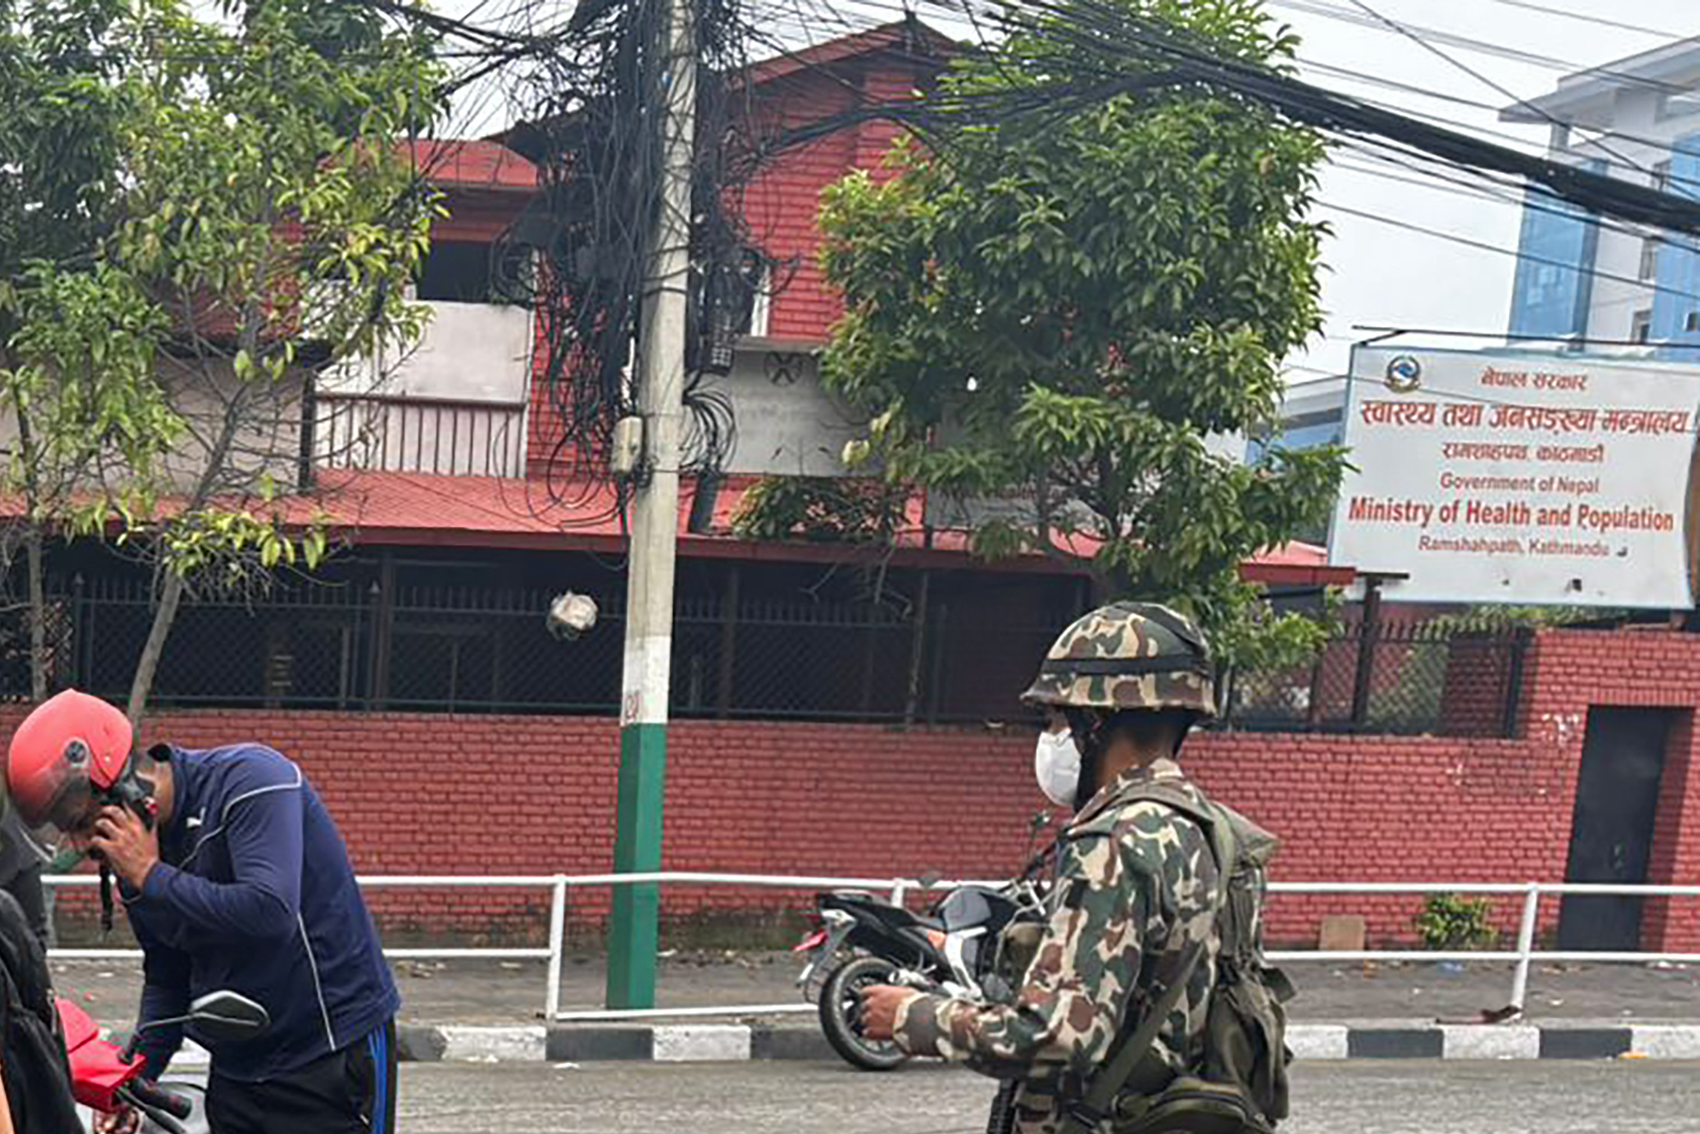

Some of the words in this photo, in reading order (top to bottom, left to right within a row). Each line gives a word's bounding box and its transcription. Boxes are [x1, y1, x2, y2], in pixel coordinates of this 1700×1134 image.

[1481, 366, 1527, 388] नेपाल
[1533, 371, 1588, 391] सरकार
[1361, 400, 1438, 427] स्वास्थ्य
[1443, 403, 1485, 428] तथा
[1601, 409, 1691, 435] मन्त्रालय
[1440, 472, 1536, 491] Government
[1538, 476, 1555, 491] of
[1557, 477, 1600, 496] Nepal
[1349, 496, 1434, 528] Ministry
[1439, 501, 1460, 523] of
[1465, 501, 1532, 526] Health
[1536, 504, 1572, 527] and
[1577, 504, 1675, 533] Population
[1418, 535, 1525, 557] Ramshahpath,
[1529, 538, 1610, 557] Kathmandu
